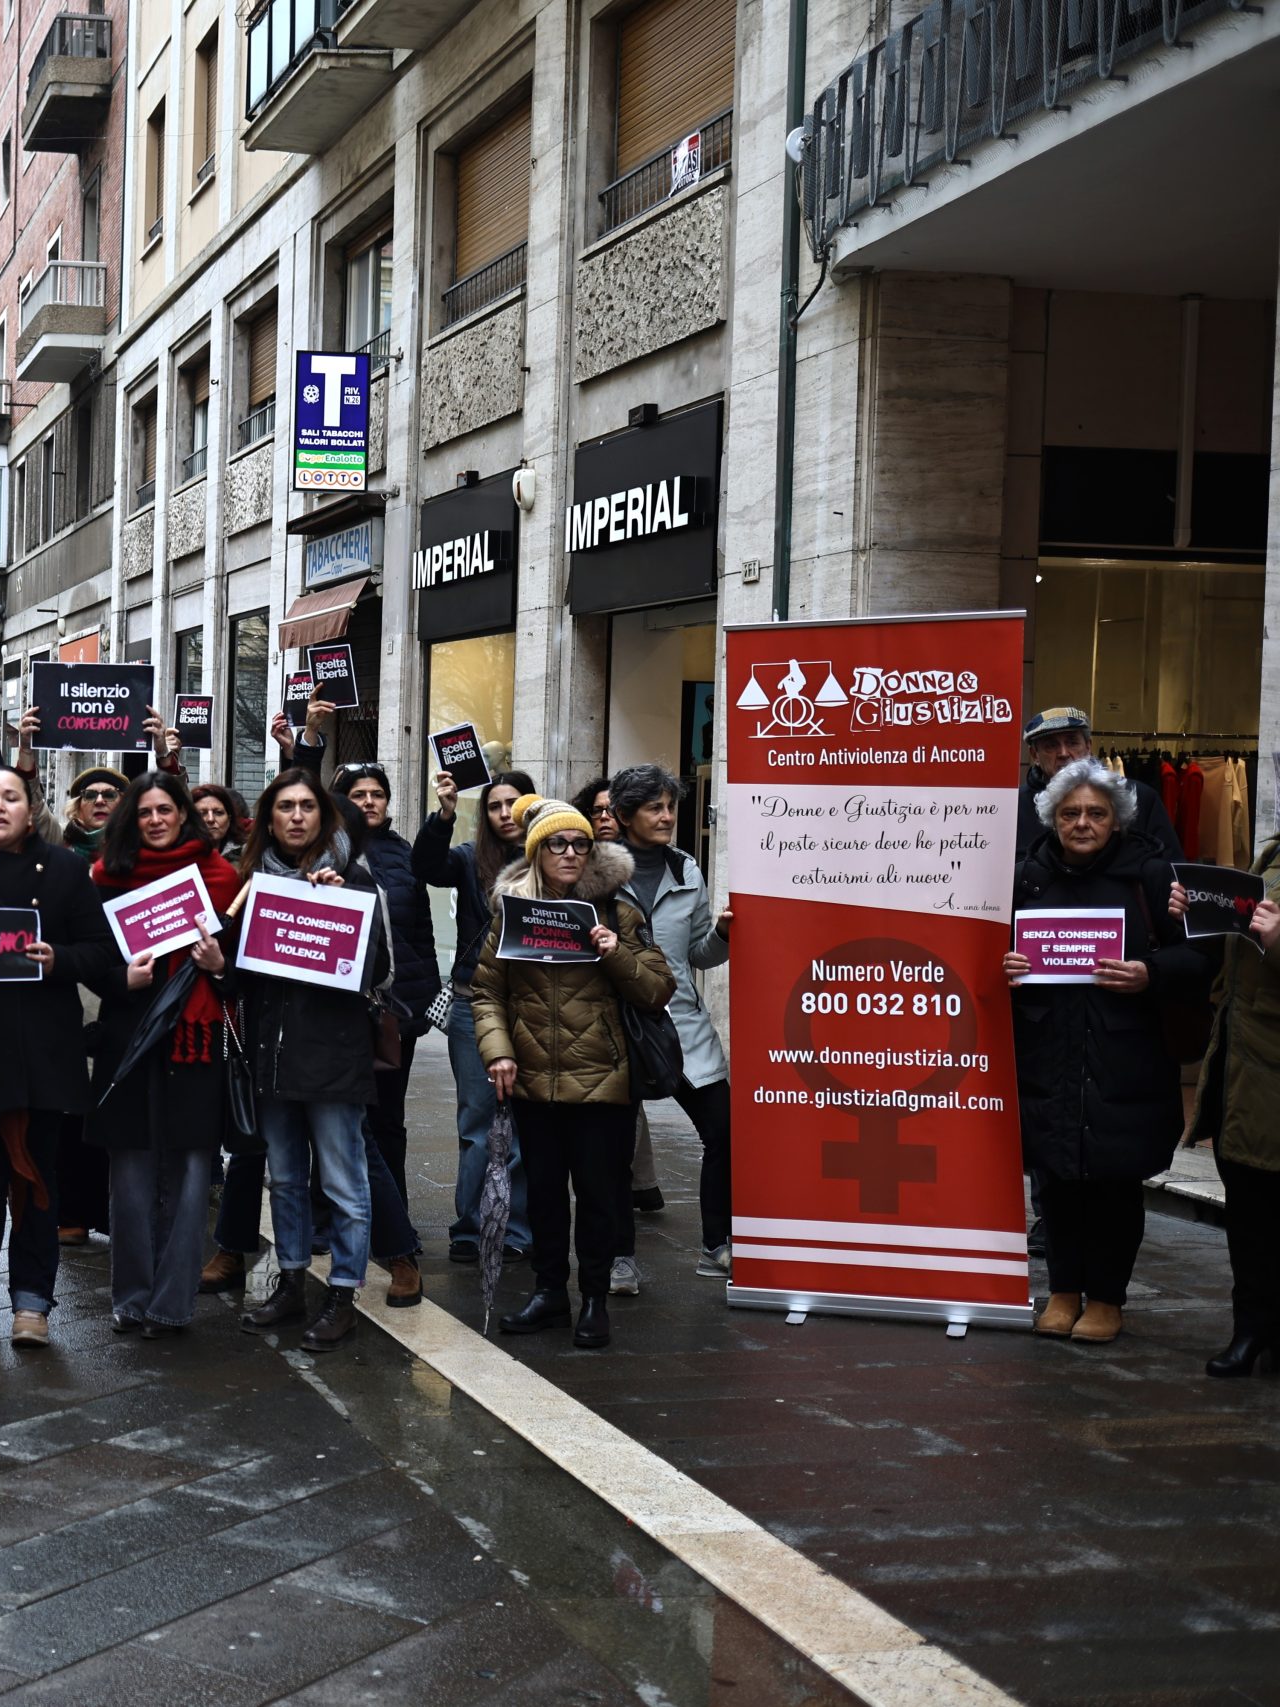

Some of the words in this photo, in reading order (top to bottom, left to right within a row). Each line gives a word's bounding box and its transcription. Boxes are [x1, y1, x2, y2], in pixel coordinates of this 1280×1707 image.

[310, 355, 357, 427] T
[344, 387, 360, 395] RIV.
[299, 438, 329, 446] VALORI
[331, 439, 365, 447] BOLLATI
[301, 429, 320, 437] SALI
[322, 430, 364, 438] TABACCHI
[565, 475, 688, 553] IMPERIAL
[307, 525, 370, 581] TABACCHERIA
[412, 529, 494, 590] IMPERIAL
[315, 658, 347, 670] scelta
[316, 668, 348, 680] libertà
[958, 672, 977, 693] &
[60, 683, 69, 697] Il
[71, 683, 130, 698] silenzio
[288, 681, 312, 691] scelta
[71, 701, 102, 714] non
[104, 699, 115, 714] è
[180, 706, 208, 715] scelta
[853, 695, 1012, 727] Giustizia
[179, 714, 207, 724] libertà
[441, 740, 474, 756] scelta
[443, 749, 477, 765] libertà
[768, 750, 815, 766] Centro
[819, 746, 908, 766] Antiviolenza
[912, 746, 926, 763] di
[930, 746, 985, 763] Ancona
[829, 806, 839, 817] e
[844, 794, 926, 823] Giustizia
[929, 801, 939, 815] è
[943, 803, 971, 822] per
[976, 804, 998, 815] me
[760, 831, 774, 851] il
[778, 835, 819, 857] posto
[822, 837, 871, 851] sicuro
[875, 830, 912, 851] dove
[915, 830, 936, 850] ho
[939, 831, 991, 856] potuto
[792, 866, 872, 884] costruirmi
[876, 864, 901, 884] ali
[124, 910, 151, 926] SENZA
[151, 890, 195, 914] CONSENSO
[933, 892, 960, 910] A.
[151, 907, 185, 926] SEMPRE
[259, 908, 295, 923] SENZA
[296, 915, 355, 935] CONSENSO
[522, 915, 546, 926] sotto
[546, 920, 580, 931] attacco
[531, 907, 568, 921] DIRITTI
[147, 918, 188, 939] VIOLENZA
[276, 927, 287, 937] E'
[287, 930, 331, 946] SEMPRE
[532, 926, 572, 939] DONNE
[1022, 931, 1056, 939] SENZA
[1058, 931, 1117, 939] CONSENSO
[274, 942, 326, 961] VIOLENZA
[522, 936, 533, 946] in
[534, 937, 581, 951] pericolo
[1041, 944, 1050, 952] E'
[1052, 944, 1096, 952] SEMPRE
[812, 959, 884, 982] Numero
[890, 960, 944, 983] Verde
[1042, 958, 1095, 966] VIOLENZA
[801, 992, 848, 1014] 800
[856, 993, 904, 1016] 032
[912, 994, 961, 1017] 810
[768, 1047, 989, 1072] www.donnegiustizia.org
[754, 1086, 1004, 1112] donne.giustizia@gmail.com
